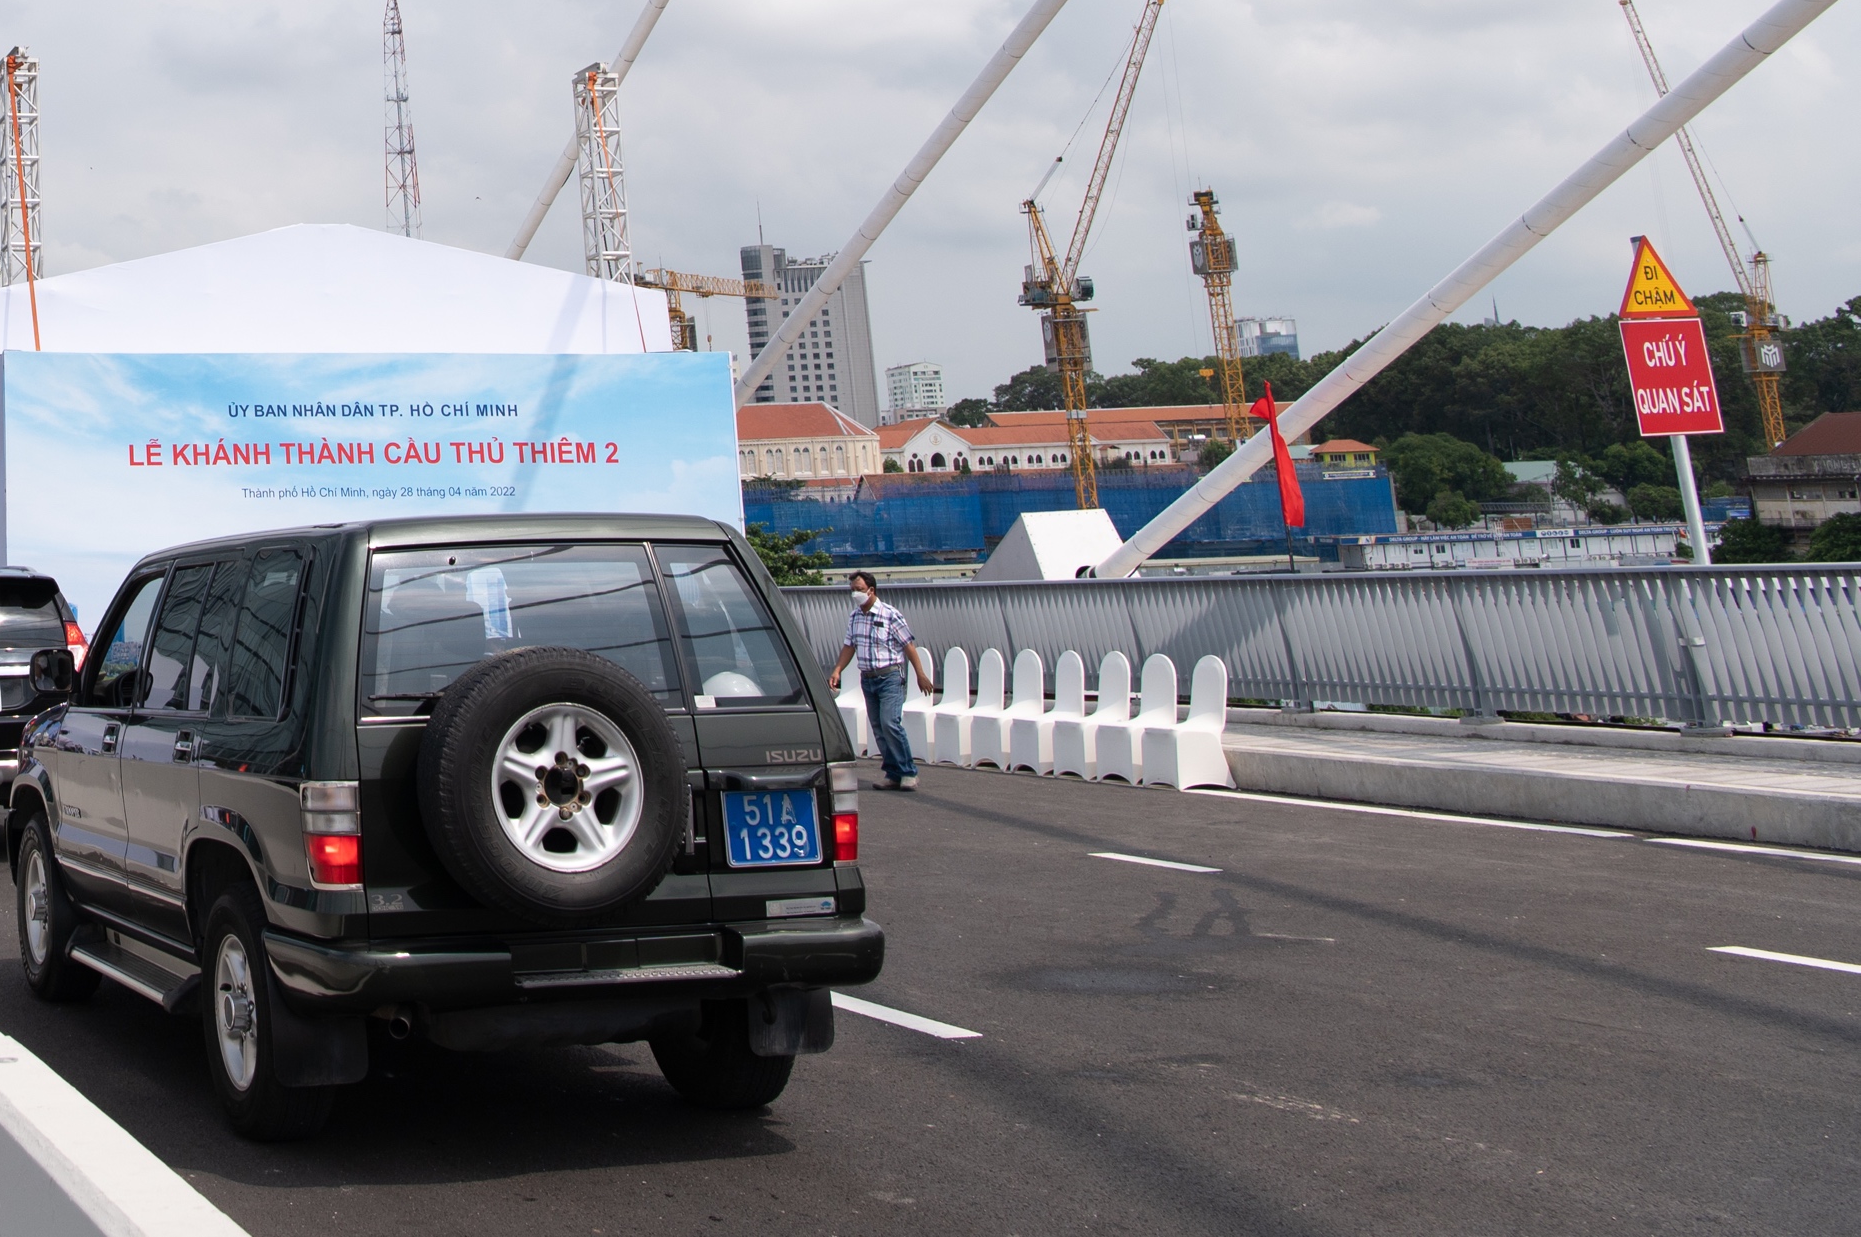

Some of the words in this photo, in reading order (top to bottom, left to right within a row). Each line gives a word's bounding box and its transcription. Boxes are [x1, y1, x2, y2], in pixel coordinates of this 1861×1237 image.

[1644, 265, 1658, 280] ĐI
[1634, 287, 1676, 309] CHẬM
[1674, 334, 1687, 366] Ý
[1637, 387, 1680, 415] QUAN
[1683, 380, 1710, 413] SÁT
[228, 402, 249, 418] ỦY
[254, 404, 287, 418] BAN
[292, 402, 337, 417] NHÂN
[342, 402, 374, 417] DÂN
[379, 404, 403, 417] TP.
[410, 401, 434, 417] HỒ
[441, 401, 469, 417] CHÍ
[476, 404, 518, 417] MINH
[129, 438, 163, 466] LỄ
[172, 438, 271, 466] KHÁNH
[279, 438, 375, 465] THÀNH
[384, 437, 442, 465] CẦU
[450, 437, 505, 464] THỦ
[513, 437, 597, 464] THIÊM
[604, 442, 619, 464] 2
[242, 488, 275, 499] Thành
[278, 486, 298, 500] phố
[301, 486, 316, 498] Hồ
[319, 487, 337, 498] Chí
[340, 487, 370, 499] Minh,
[372, 487, 397, 500] ngày
[400, 487, 413, 497] 28
[416, 486, 445, 499] tháng
[448, 487, 461, 497] 04
[465, 487, 487, 496] năm
[490, 486, 515, 497] 2022
[765, 749, 822, 763] ISUZU
[743, 793, 797, 826] 51A
[740, 825, 808, 860] 1339
[371, 894, 403, 905] 3.2
